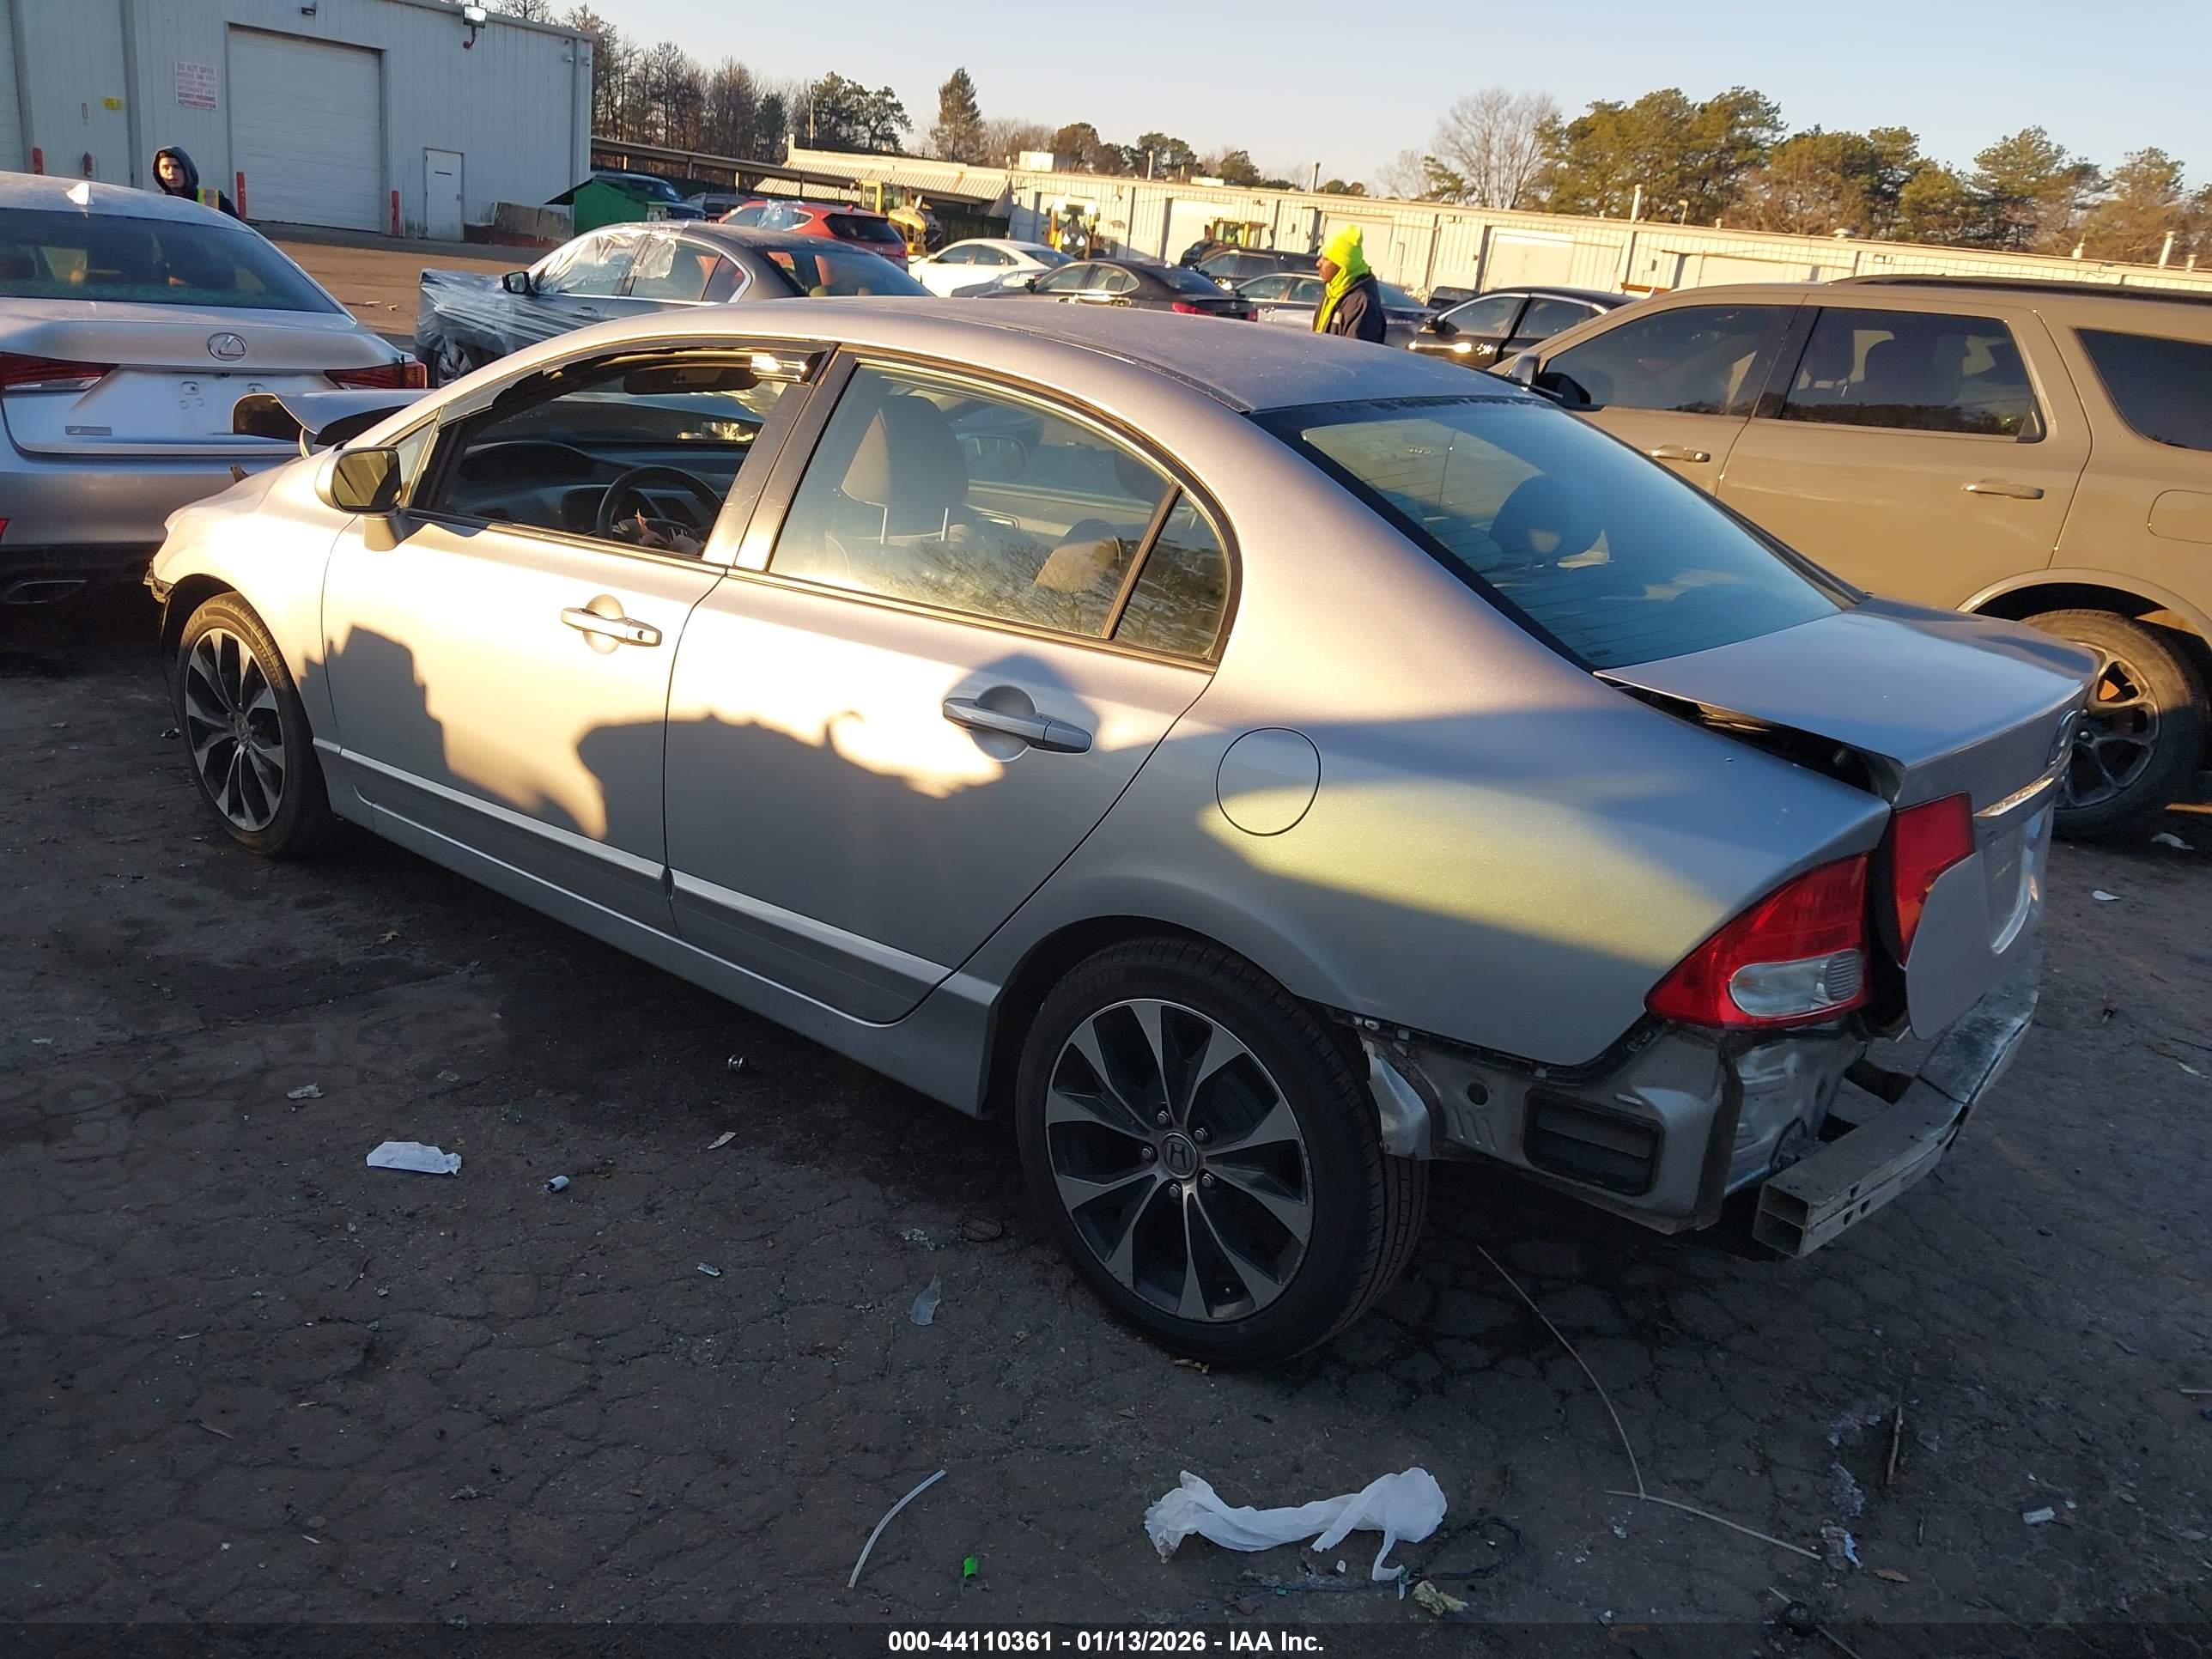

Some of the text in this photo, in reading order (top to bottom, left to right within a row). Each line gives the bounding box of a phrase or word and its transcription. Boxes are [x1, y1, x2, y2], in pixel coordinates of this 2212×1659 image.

[177, 63, 215, 76] DO NOT OPEN
